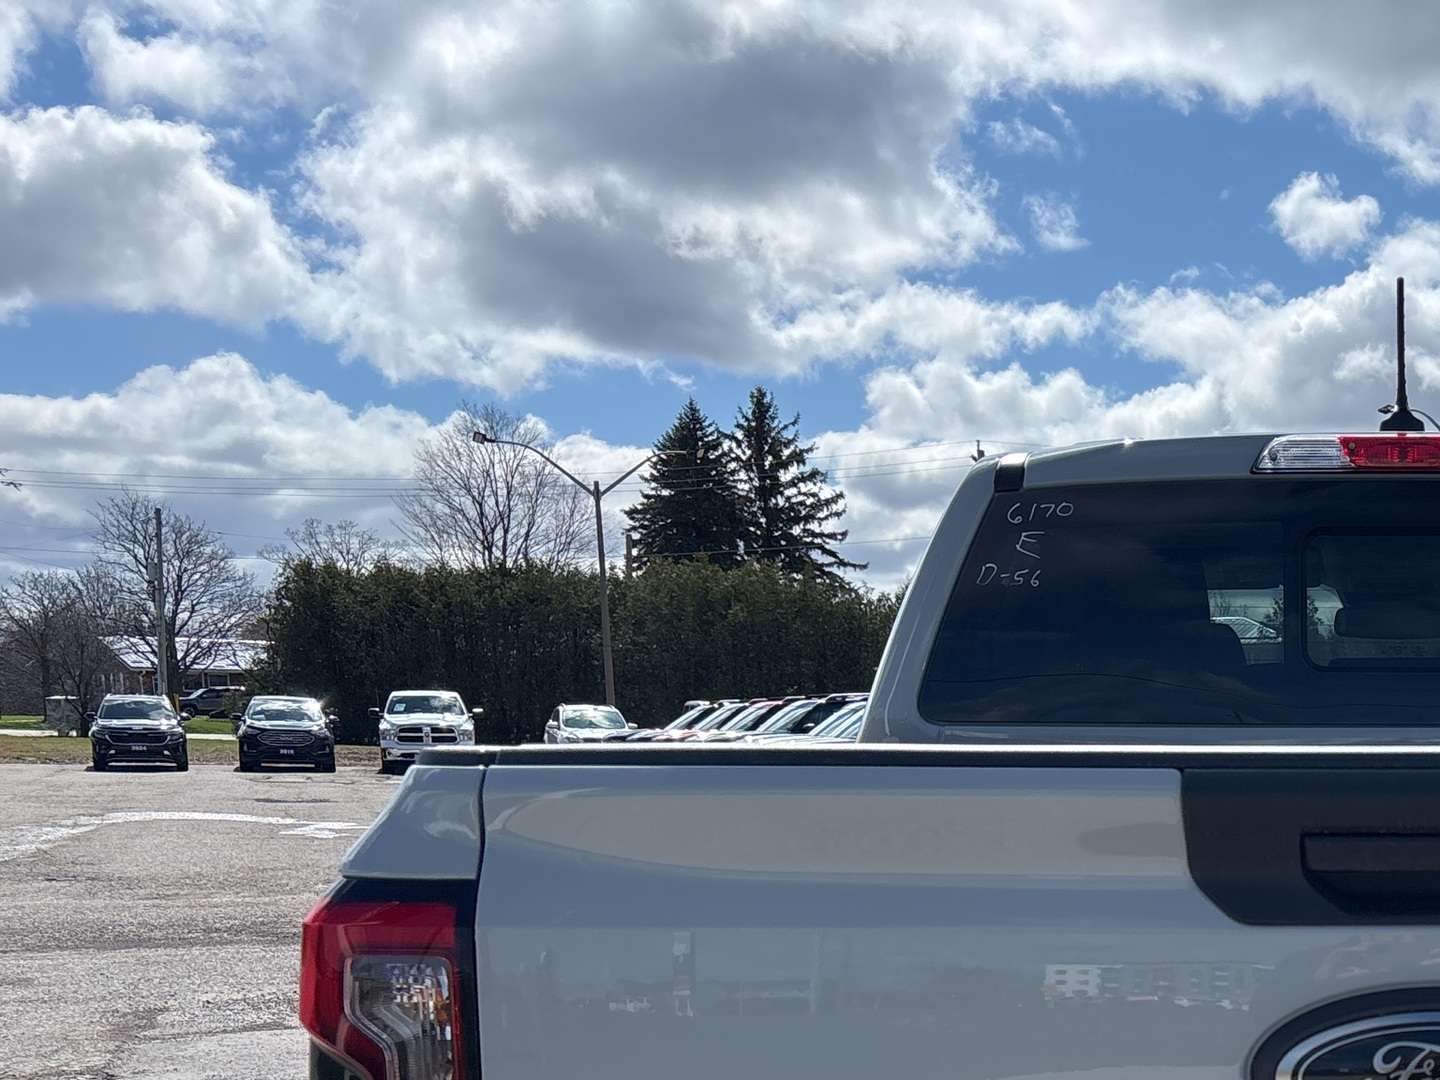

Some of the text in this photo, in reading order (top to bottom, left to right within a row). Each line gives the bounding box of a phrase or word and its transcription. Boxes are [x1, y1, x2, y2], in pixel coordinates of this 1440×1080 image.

[1007, 502, 1074, 524] 6170
[1016, 531, 1045, 559] E
[976, 563, 1041, 587] D-56
